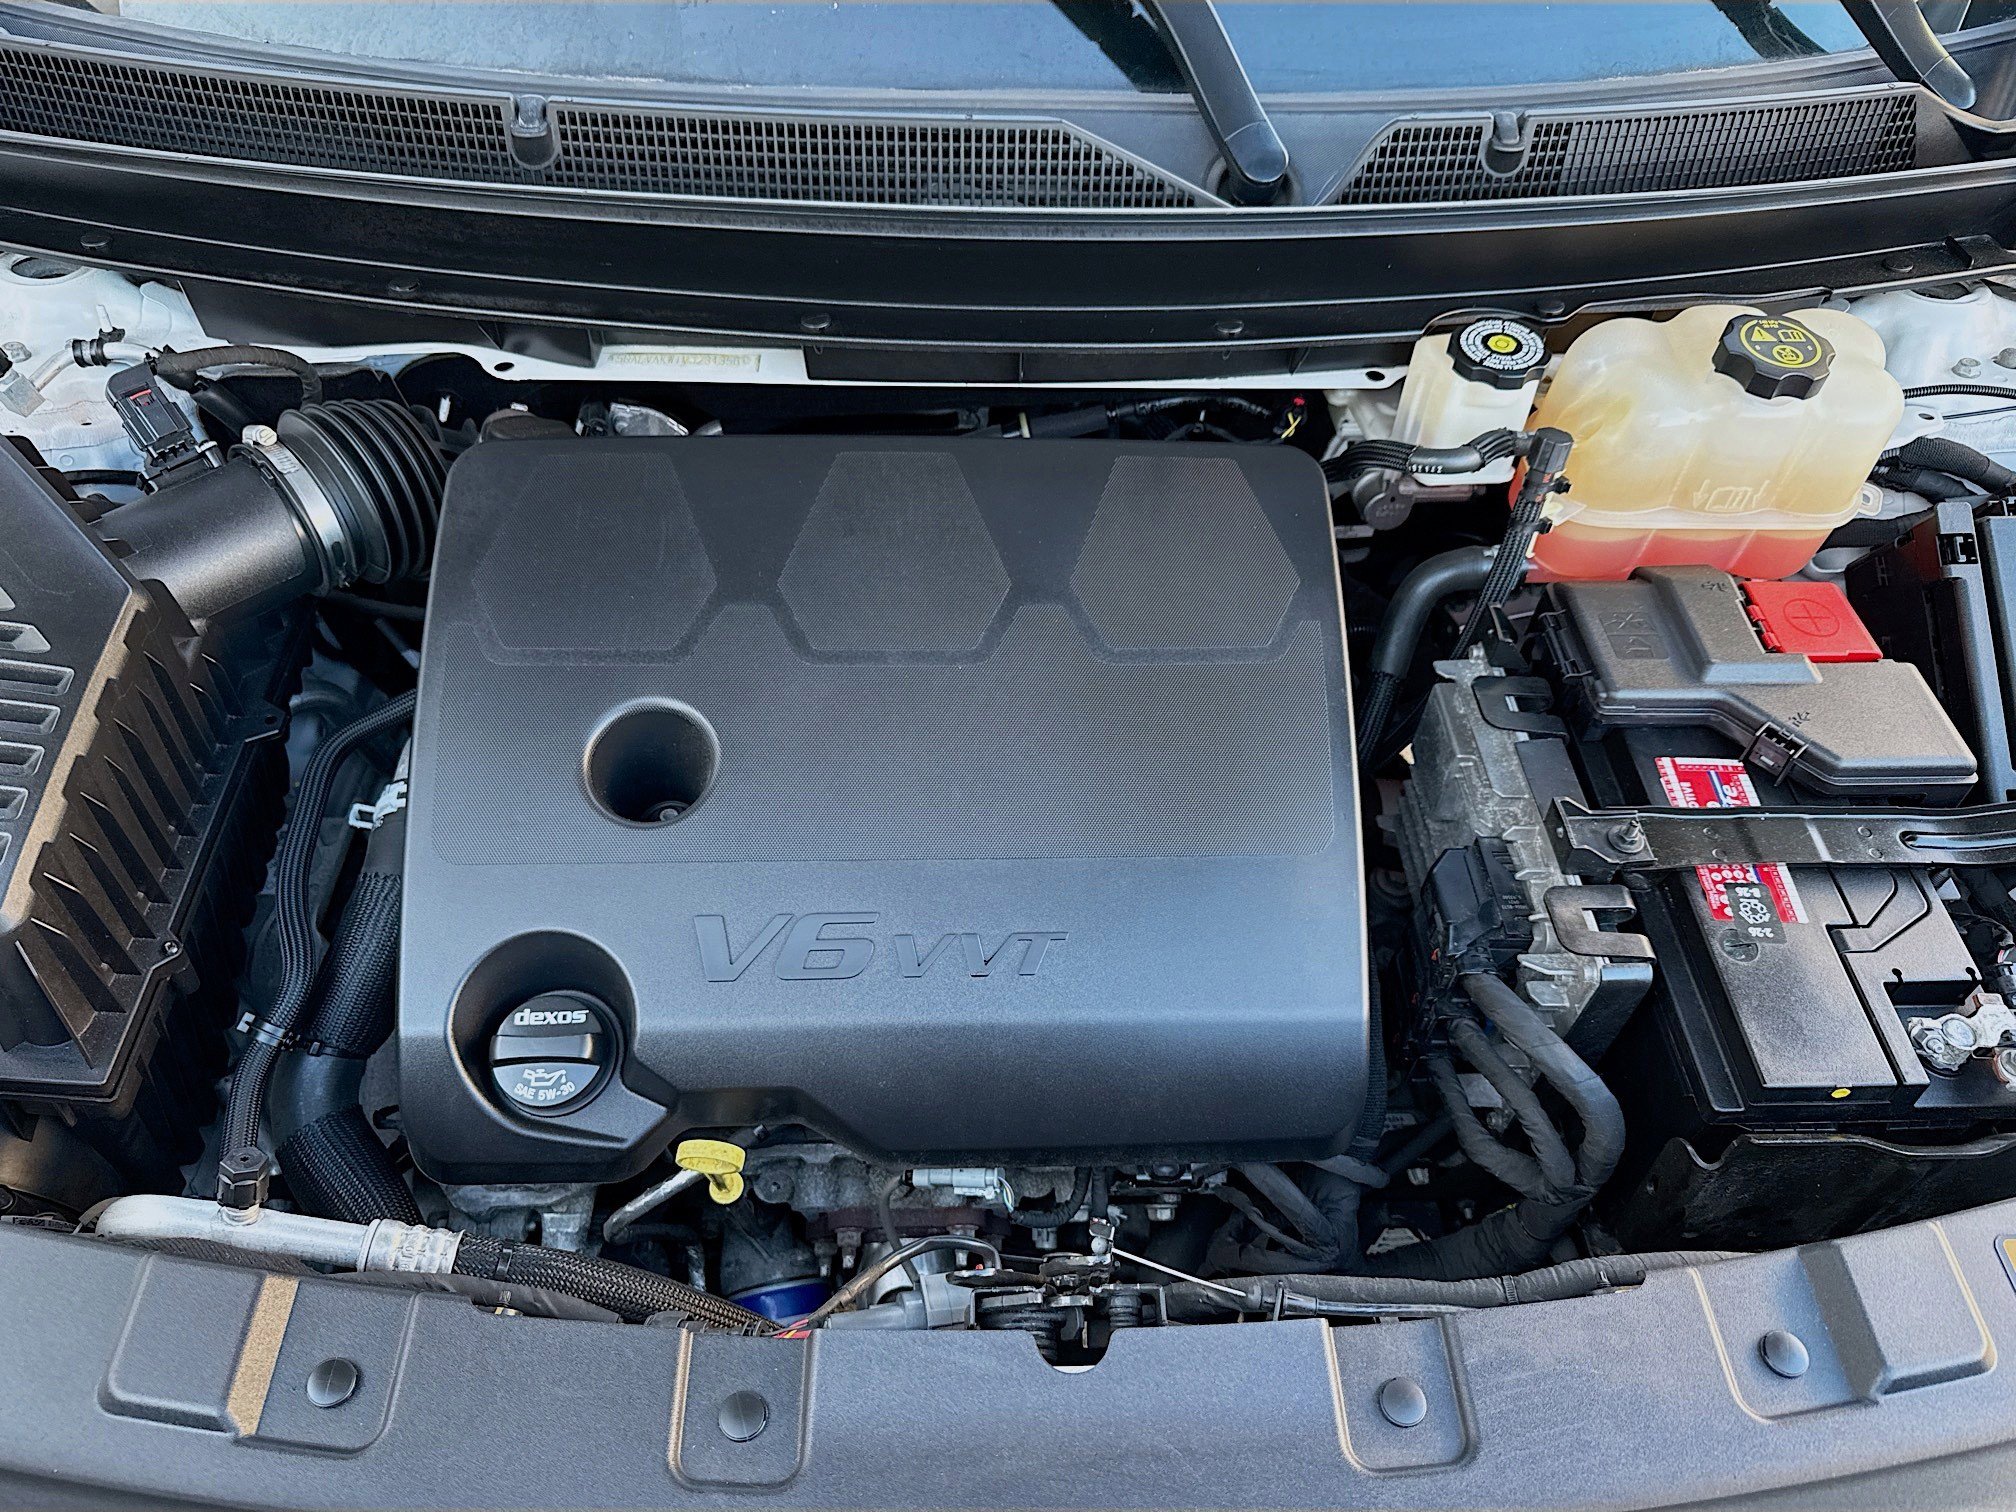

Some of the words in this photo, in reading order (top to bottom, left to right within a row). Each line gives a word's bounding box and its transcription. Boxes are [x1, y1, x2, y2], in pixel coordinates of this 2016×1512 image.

[693, 911, 880, 983] V6
[894, 931, 1069, 978] VVT
[513, 1008, 589, 1026] dexos
[513, 1082, 536, 1100] SAE
[538, 1081, 576, 1101] 5W-30
